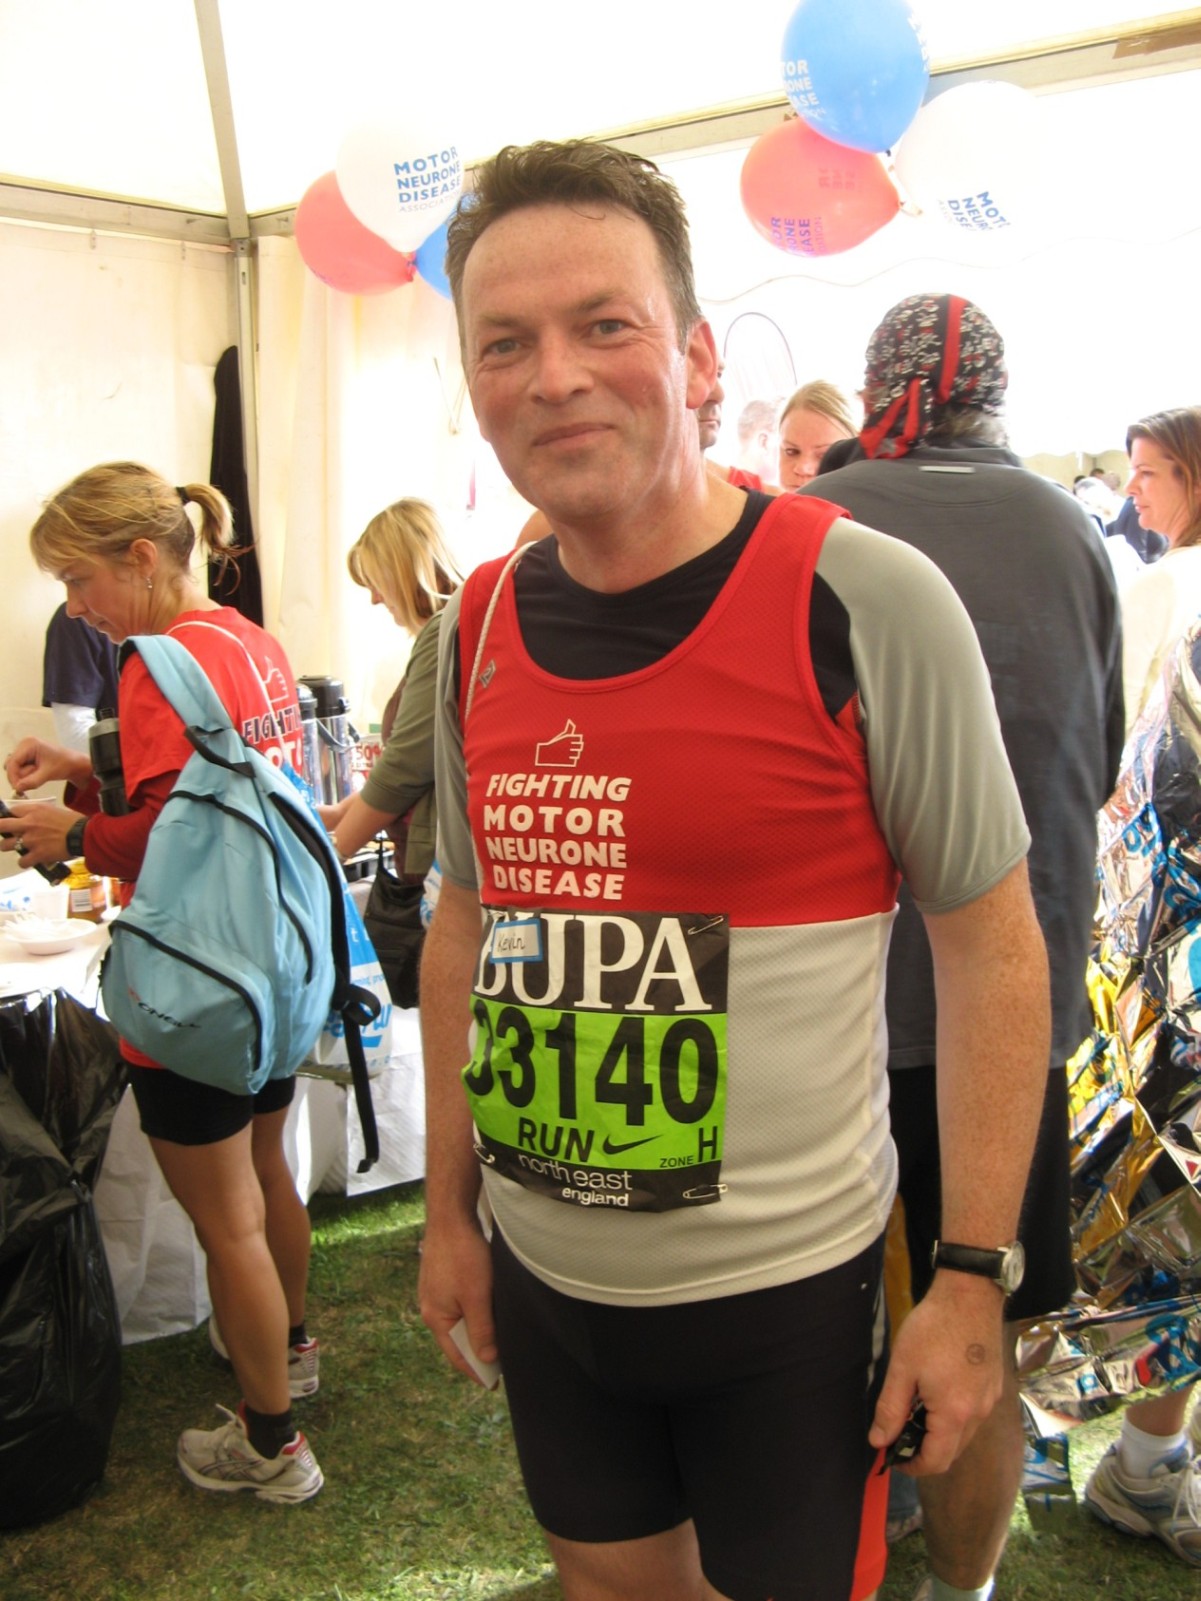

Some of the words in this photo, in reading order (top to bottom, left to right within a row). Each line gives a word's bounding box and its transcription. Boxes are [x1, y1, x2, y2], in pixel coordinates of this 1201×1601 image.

[394, 146, 458, 176] MOTOR
[397, 160, 460, 190] NEURONE
[399, 175, 461, 203] DISEASE
[485, 773, 632, 802] FIGHTING
[483, 804, 626, 837] MOTOR
[485, 836, 627, 869] NEURONE
[492, 864, 625, 900] DISEASE
[496, 931, 526, 953] Kevin
[518, 1117, 595, 1163] RUN
[659, 1155, 694, 1169] ZONE
[698, 1125, 718, 1163] H
[562, 1187, 629, 1207] england
